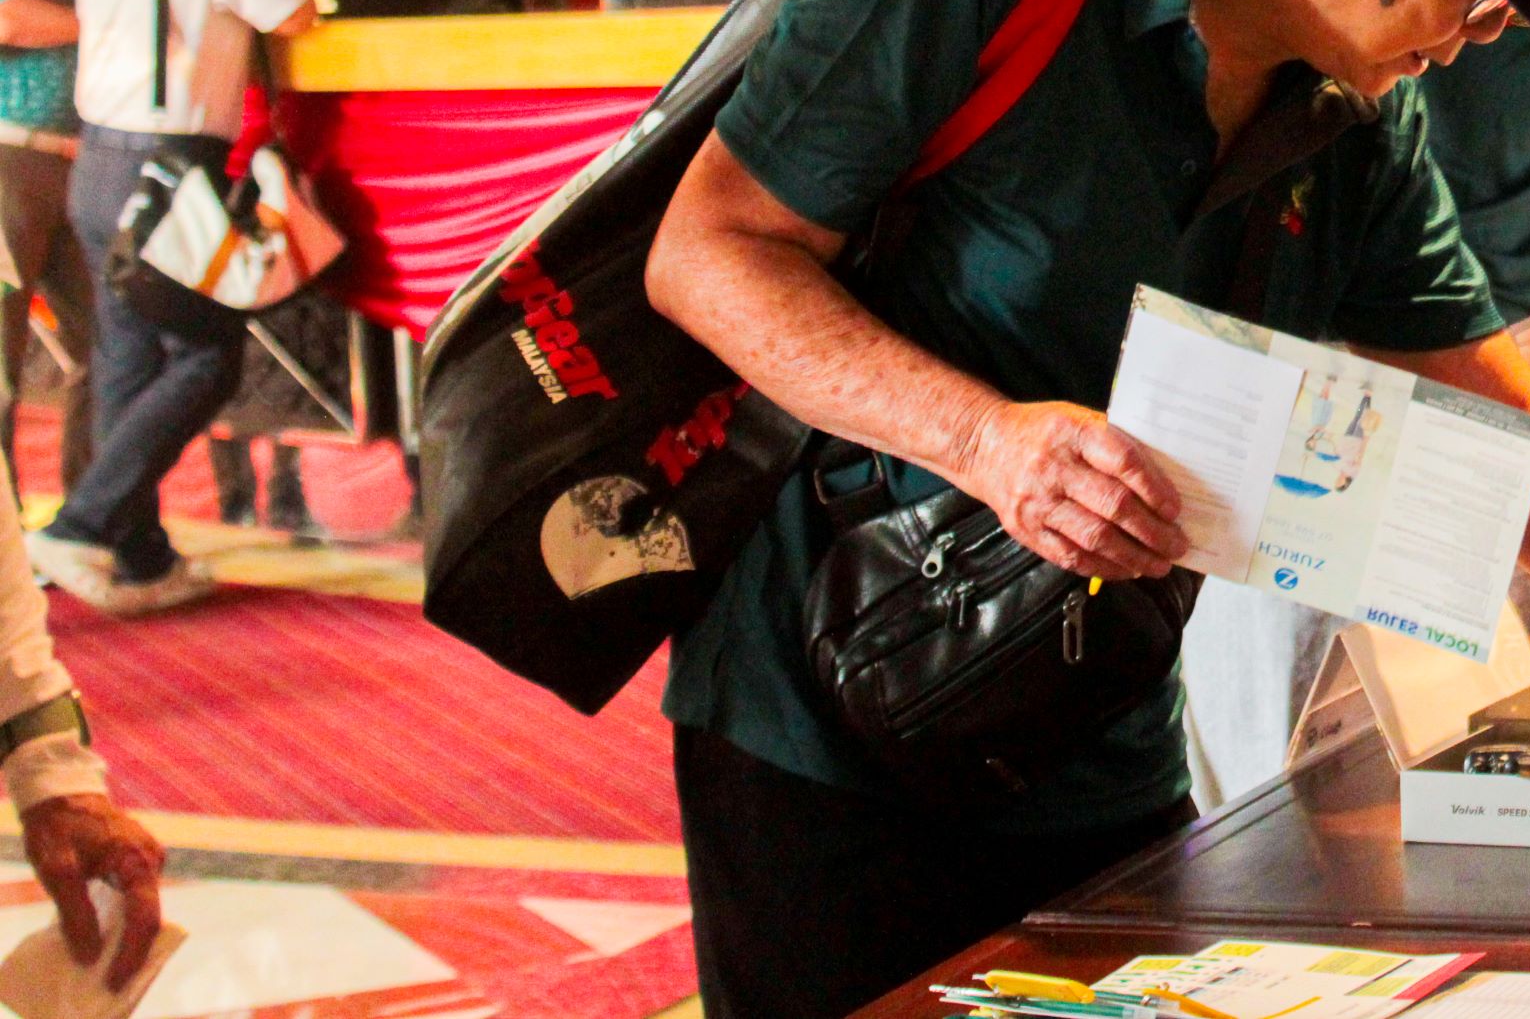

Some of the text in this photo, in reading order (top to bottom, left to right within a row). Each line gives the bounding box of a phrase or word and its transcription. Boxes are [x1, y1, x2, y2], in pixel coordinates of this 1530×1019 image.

[511, 328, 568, 404] MALAYSIA
[1258, 540, 1327, 571] ZURICH
[1425, 625, 1479, 657] LOCAL
[1451, 804, 1485, 816] Volvik
[1497, 807, 1528, 818] SPEED
